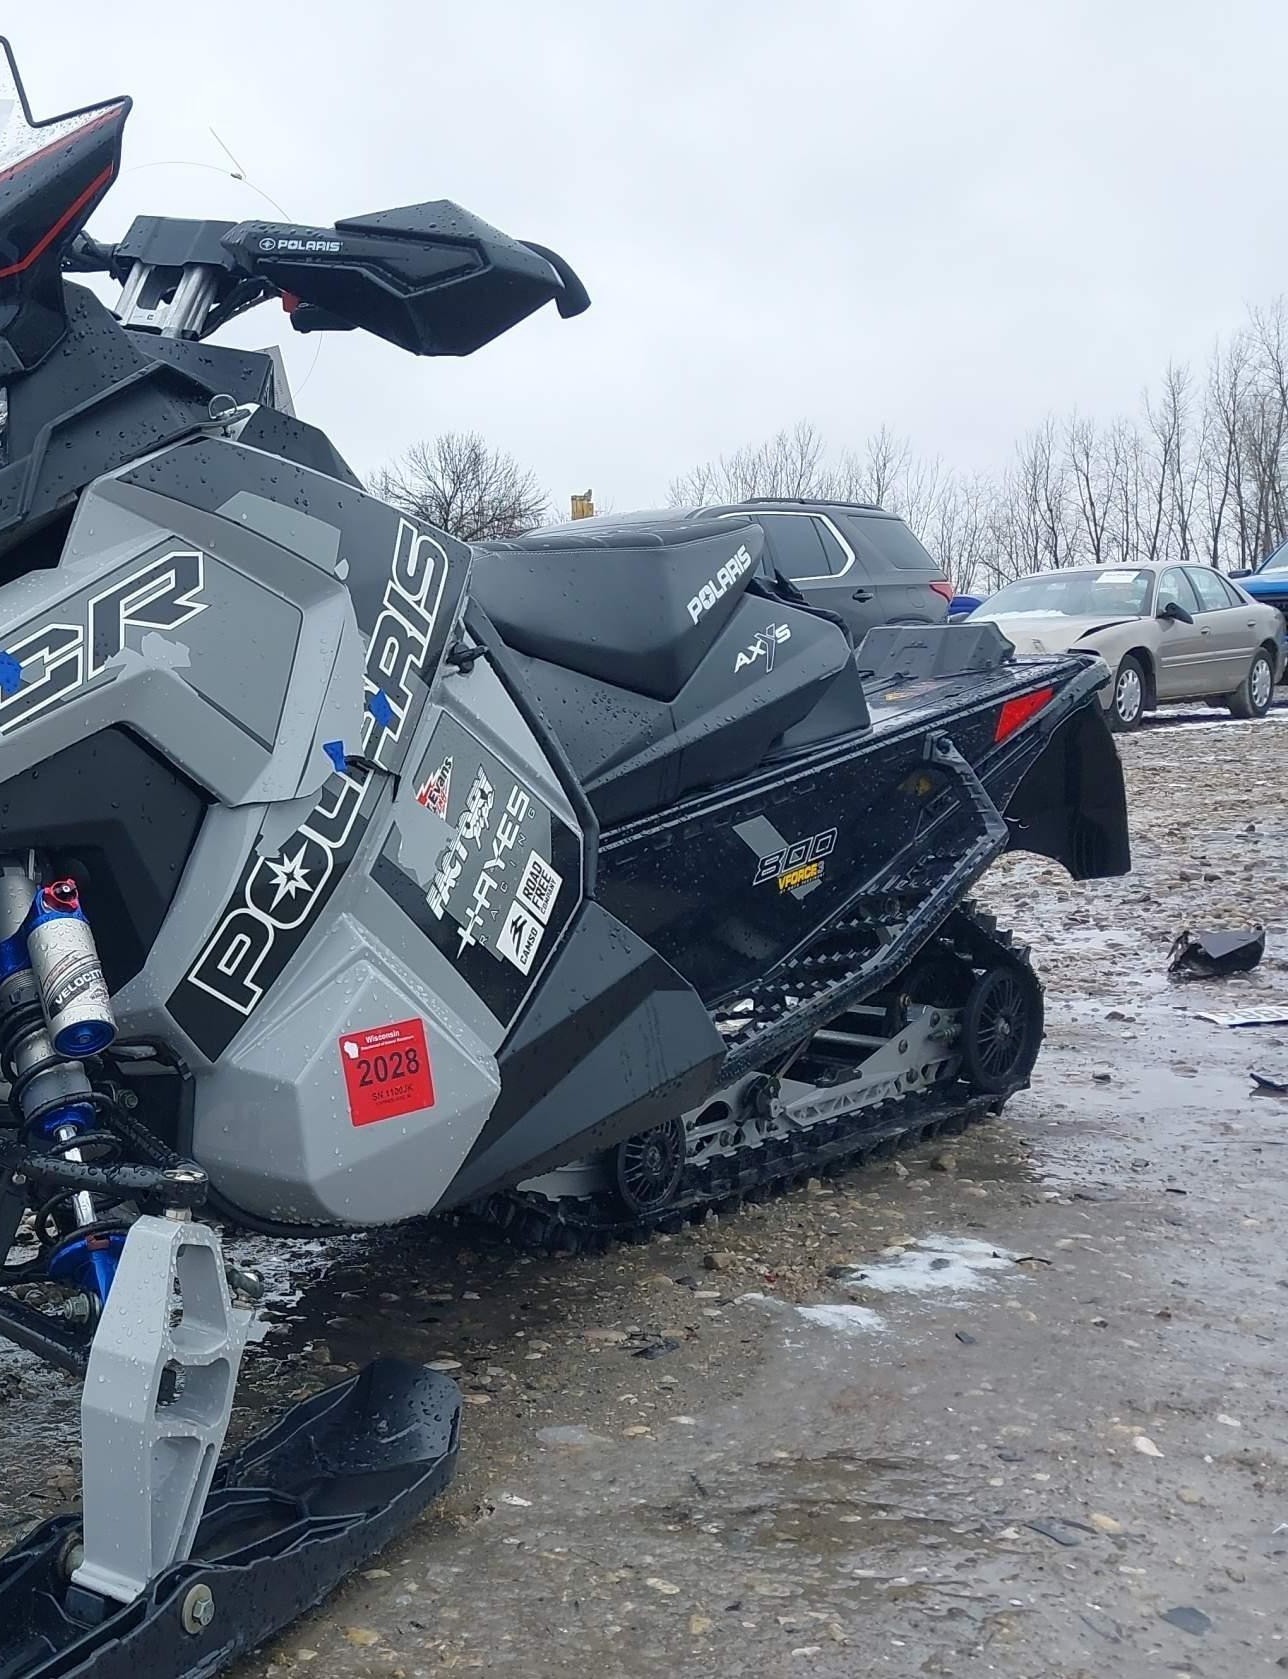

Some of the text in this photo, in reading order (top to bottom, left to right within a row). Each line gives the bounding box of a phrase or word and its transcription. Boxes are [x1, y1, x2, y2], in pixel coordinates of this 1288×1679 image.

[277, 239, 341, 252] POLARIS
[686, 544, 751, 625] POLARIS
[734, 623, 791, 673] AXYS
[457, 784, 530, 959] HAYES
[479, 807, 536, 945] RACING
[752, 827, 837, 886] 800
[522, 860, 543, 900] ROAD
[532, 870, 553, 909] FREE
[540, 877, 558, 915] COMPANY
[520, 927, 538, 965] CAMSO
[55, 969, 103, 1004] VELOCITY
[365, 1030, 400, 1044] Wisconsin
[357, 1047, 420, 1087] 2028
